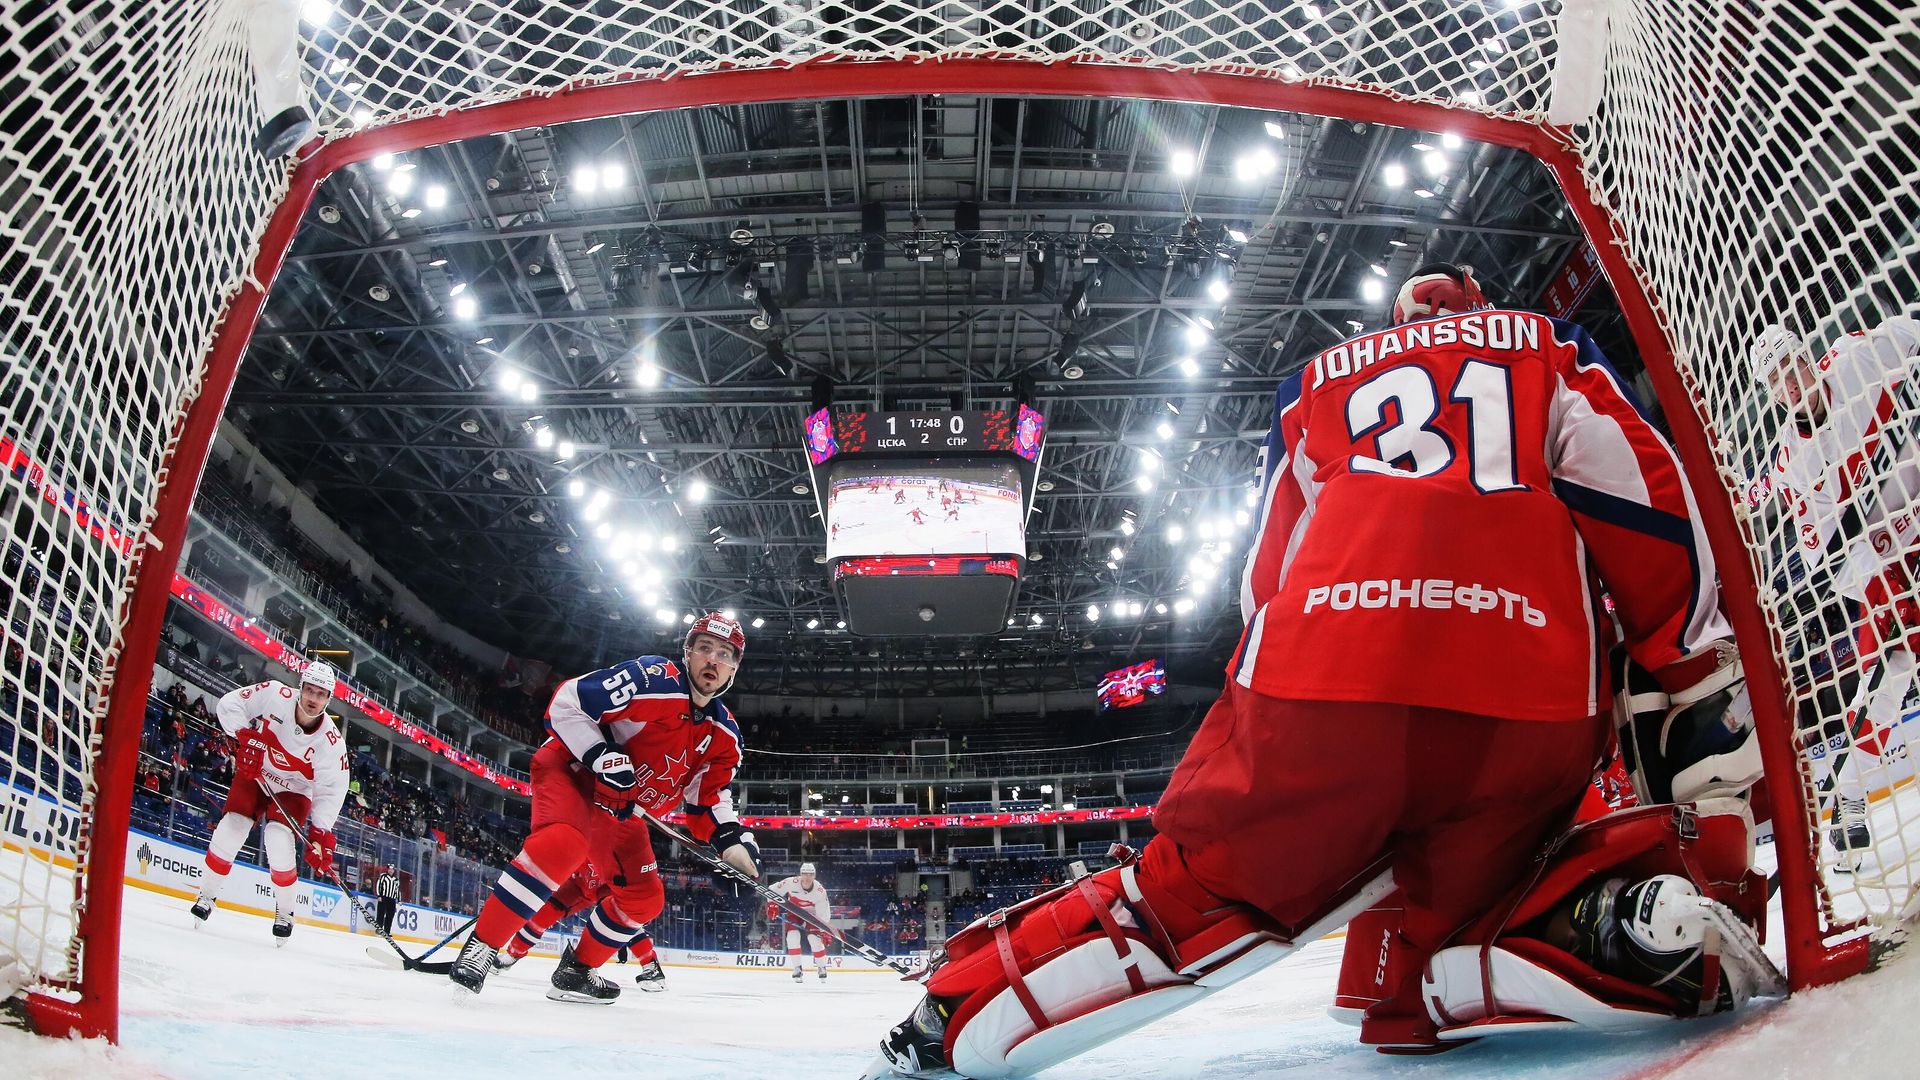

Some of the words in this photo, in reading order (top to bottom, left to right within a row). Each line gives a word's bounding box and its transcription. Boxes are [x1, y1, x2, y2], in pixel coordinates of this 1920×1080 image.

[1312, 313, 1539, 391] JOHANSSON
[886, 416, 897, 435] 1
[909, 418, 941, 429] 17:48
[949, 415, 964, 435] 0
[1344, 359, 1532, 495] 31
[877, 438, 906, 448] ЦСКА
[920, 433, 930, 444] 2
[946, 437, 968, 446] СПР
[204, 549, 221, 567] 421
[278, 603, 294, 620] 422
[1302, 579, 1547, 628] РОСНЕФТЬ
[708, 622, 730, 635] согаз
[601, 669, 637, 706] 55
[303, 746, 315, 762] C
[694, 734, 713, 755] A
[706, 856, 786, 904] JETSPEED
[255, 883, 271, 897] THE
[312, 893, 337, 915] SAP
[1642, 883, 1658, 919] CCM
[736, 954, 786, 969] KHL.RU
[1375, 928, 1391, 986] CCM
